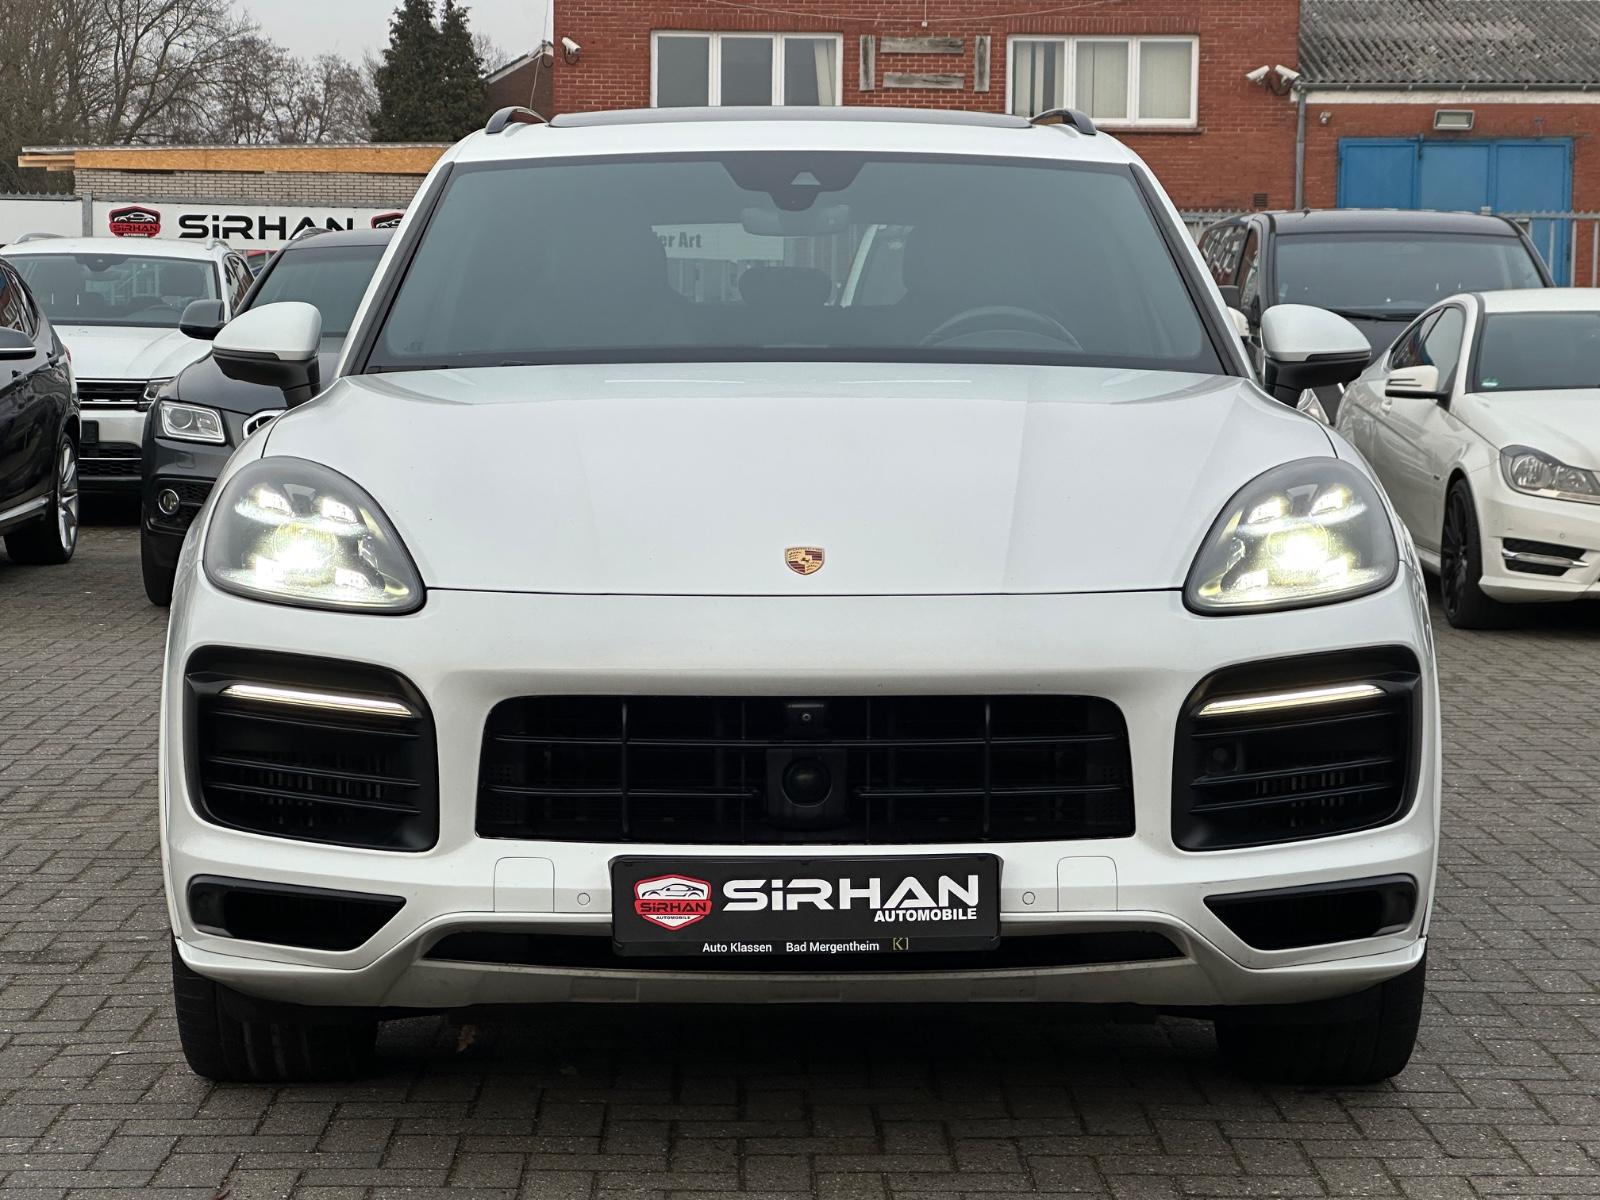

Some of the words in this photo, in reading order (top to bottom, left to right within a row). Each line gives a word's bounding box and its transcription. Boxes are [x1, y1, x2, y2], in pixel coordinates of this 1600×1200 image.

[679, 231, 702, 248] Art
[874, 908, 977, 923] AUTOMOBILE
[702, 942, 728, 953] Auto
[730, 942, 772, 953] Klassen
[786, 942, 807, 952] Bad
[809, 941, 880, 954] Mergentheim
